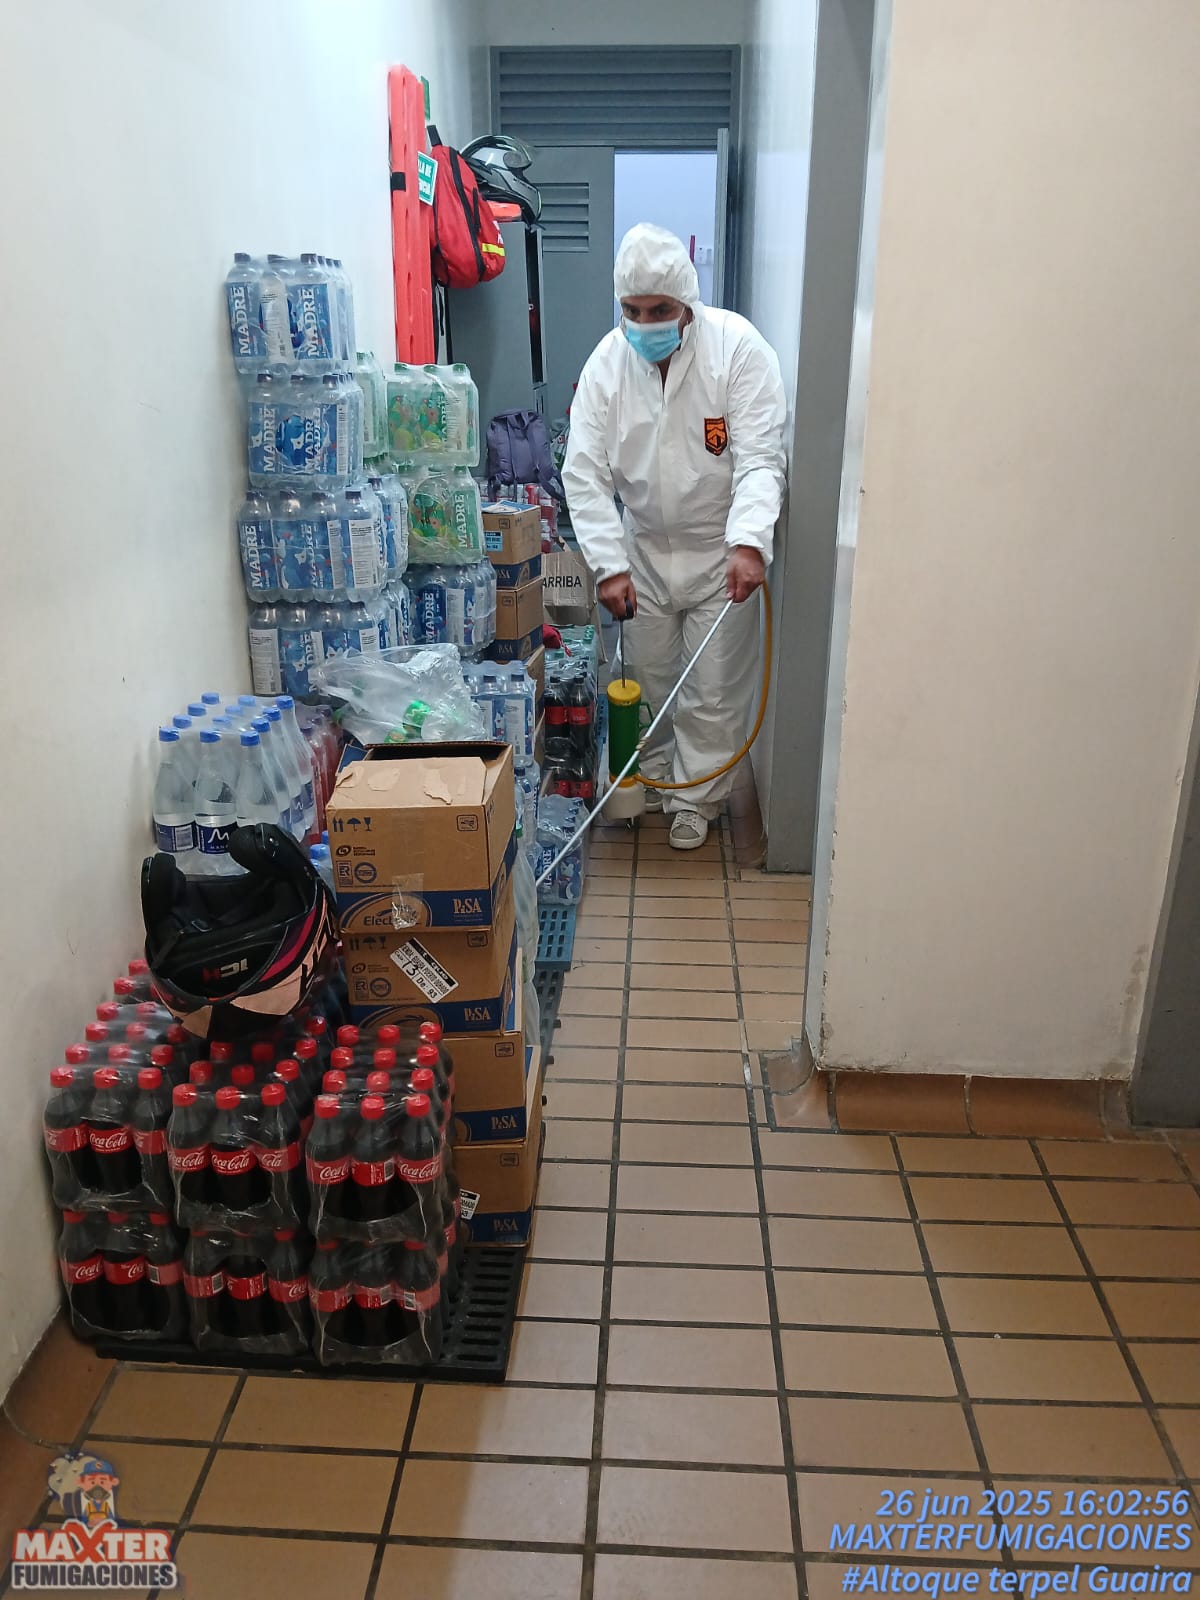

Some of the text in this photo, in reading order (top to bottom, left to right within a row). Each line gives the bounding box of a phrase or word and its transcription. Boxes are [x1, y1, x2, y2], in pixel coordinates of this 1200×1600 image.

[234, 286, 251, 356] MADRE
[301, 288, 320, 357] MADRE
[263, 408, 276, 473] MADRE
[455, 494, 467, 548] MADRE
[246, 525, 262, 588] MADRE
[542, 576, 582, 589] ARRIBA
[425, 593, 435, 645] MADRE
